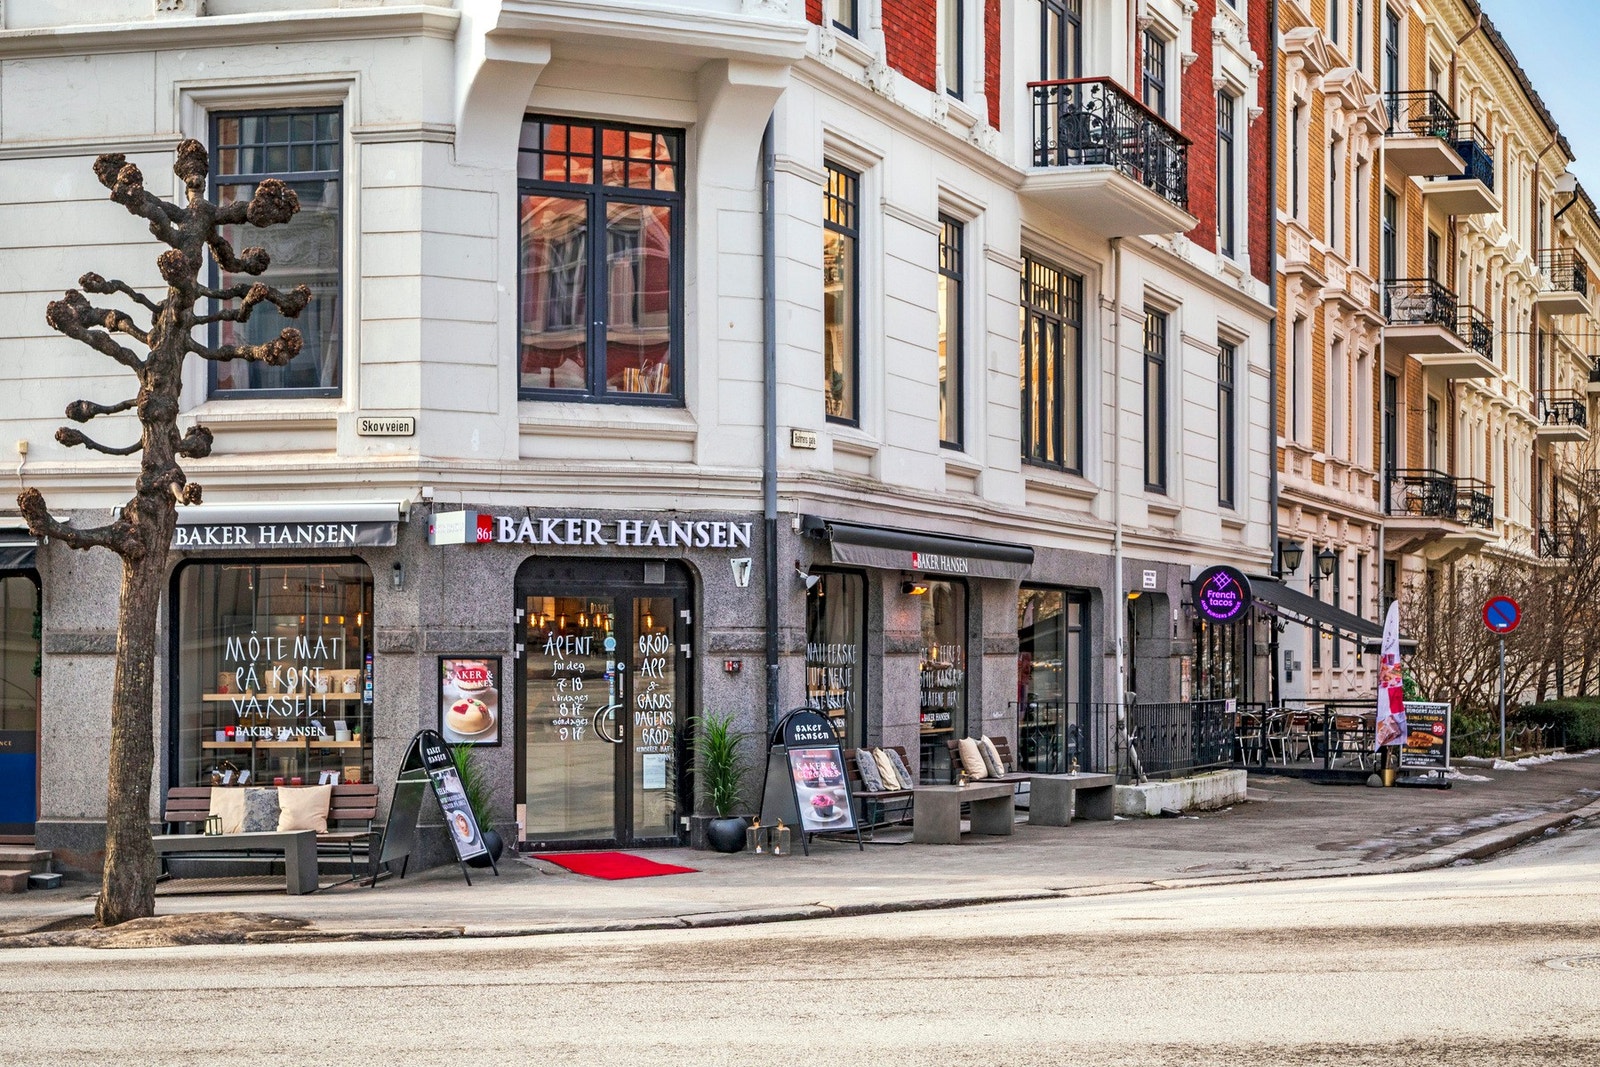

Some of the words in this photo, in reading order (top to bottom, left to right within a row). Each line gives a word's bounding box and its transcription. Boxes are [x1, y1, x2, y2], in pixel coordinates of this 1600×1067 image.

[362, 420, 409, 432] Skovveien
[175, 526, 251, 546] BAKER
[258, 524, 358, 544] HANSEN
[496, 516, 608, 546] BAKER
[615, 519, 753, 548] HANSEN
[917, 553, 939, 570] BAKER
[940, 555, 969, 573] HANSEN
[1207, 590, 1236, 600] French
[1209, 598, 1233, 607] tacos
[225, 630, 287, 662] MÖTE
[294, 635, 342, 660] MAT
[542, 631, 593, 660] ÅPENT
[447, 670, 482, 679] KAKER
[486, 670, 494, 679] &
[566, 661, 586, 674] deg
[235, 663, 261, 692] PÅ
[273, 665, 324, 690] KORT
[232, 695, 326, 719] VARSEL!
[635, 711, 673, 726] DAGENS
[236, 726, 273, 737] BAKER
[277, 726, 326, 737] HANSEN
[796, 762, 828, 771] KAKER
[830, 762, 838, 771] &
